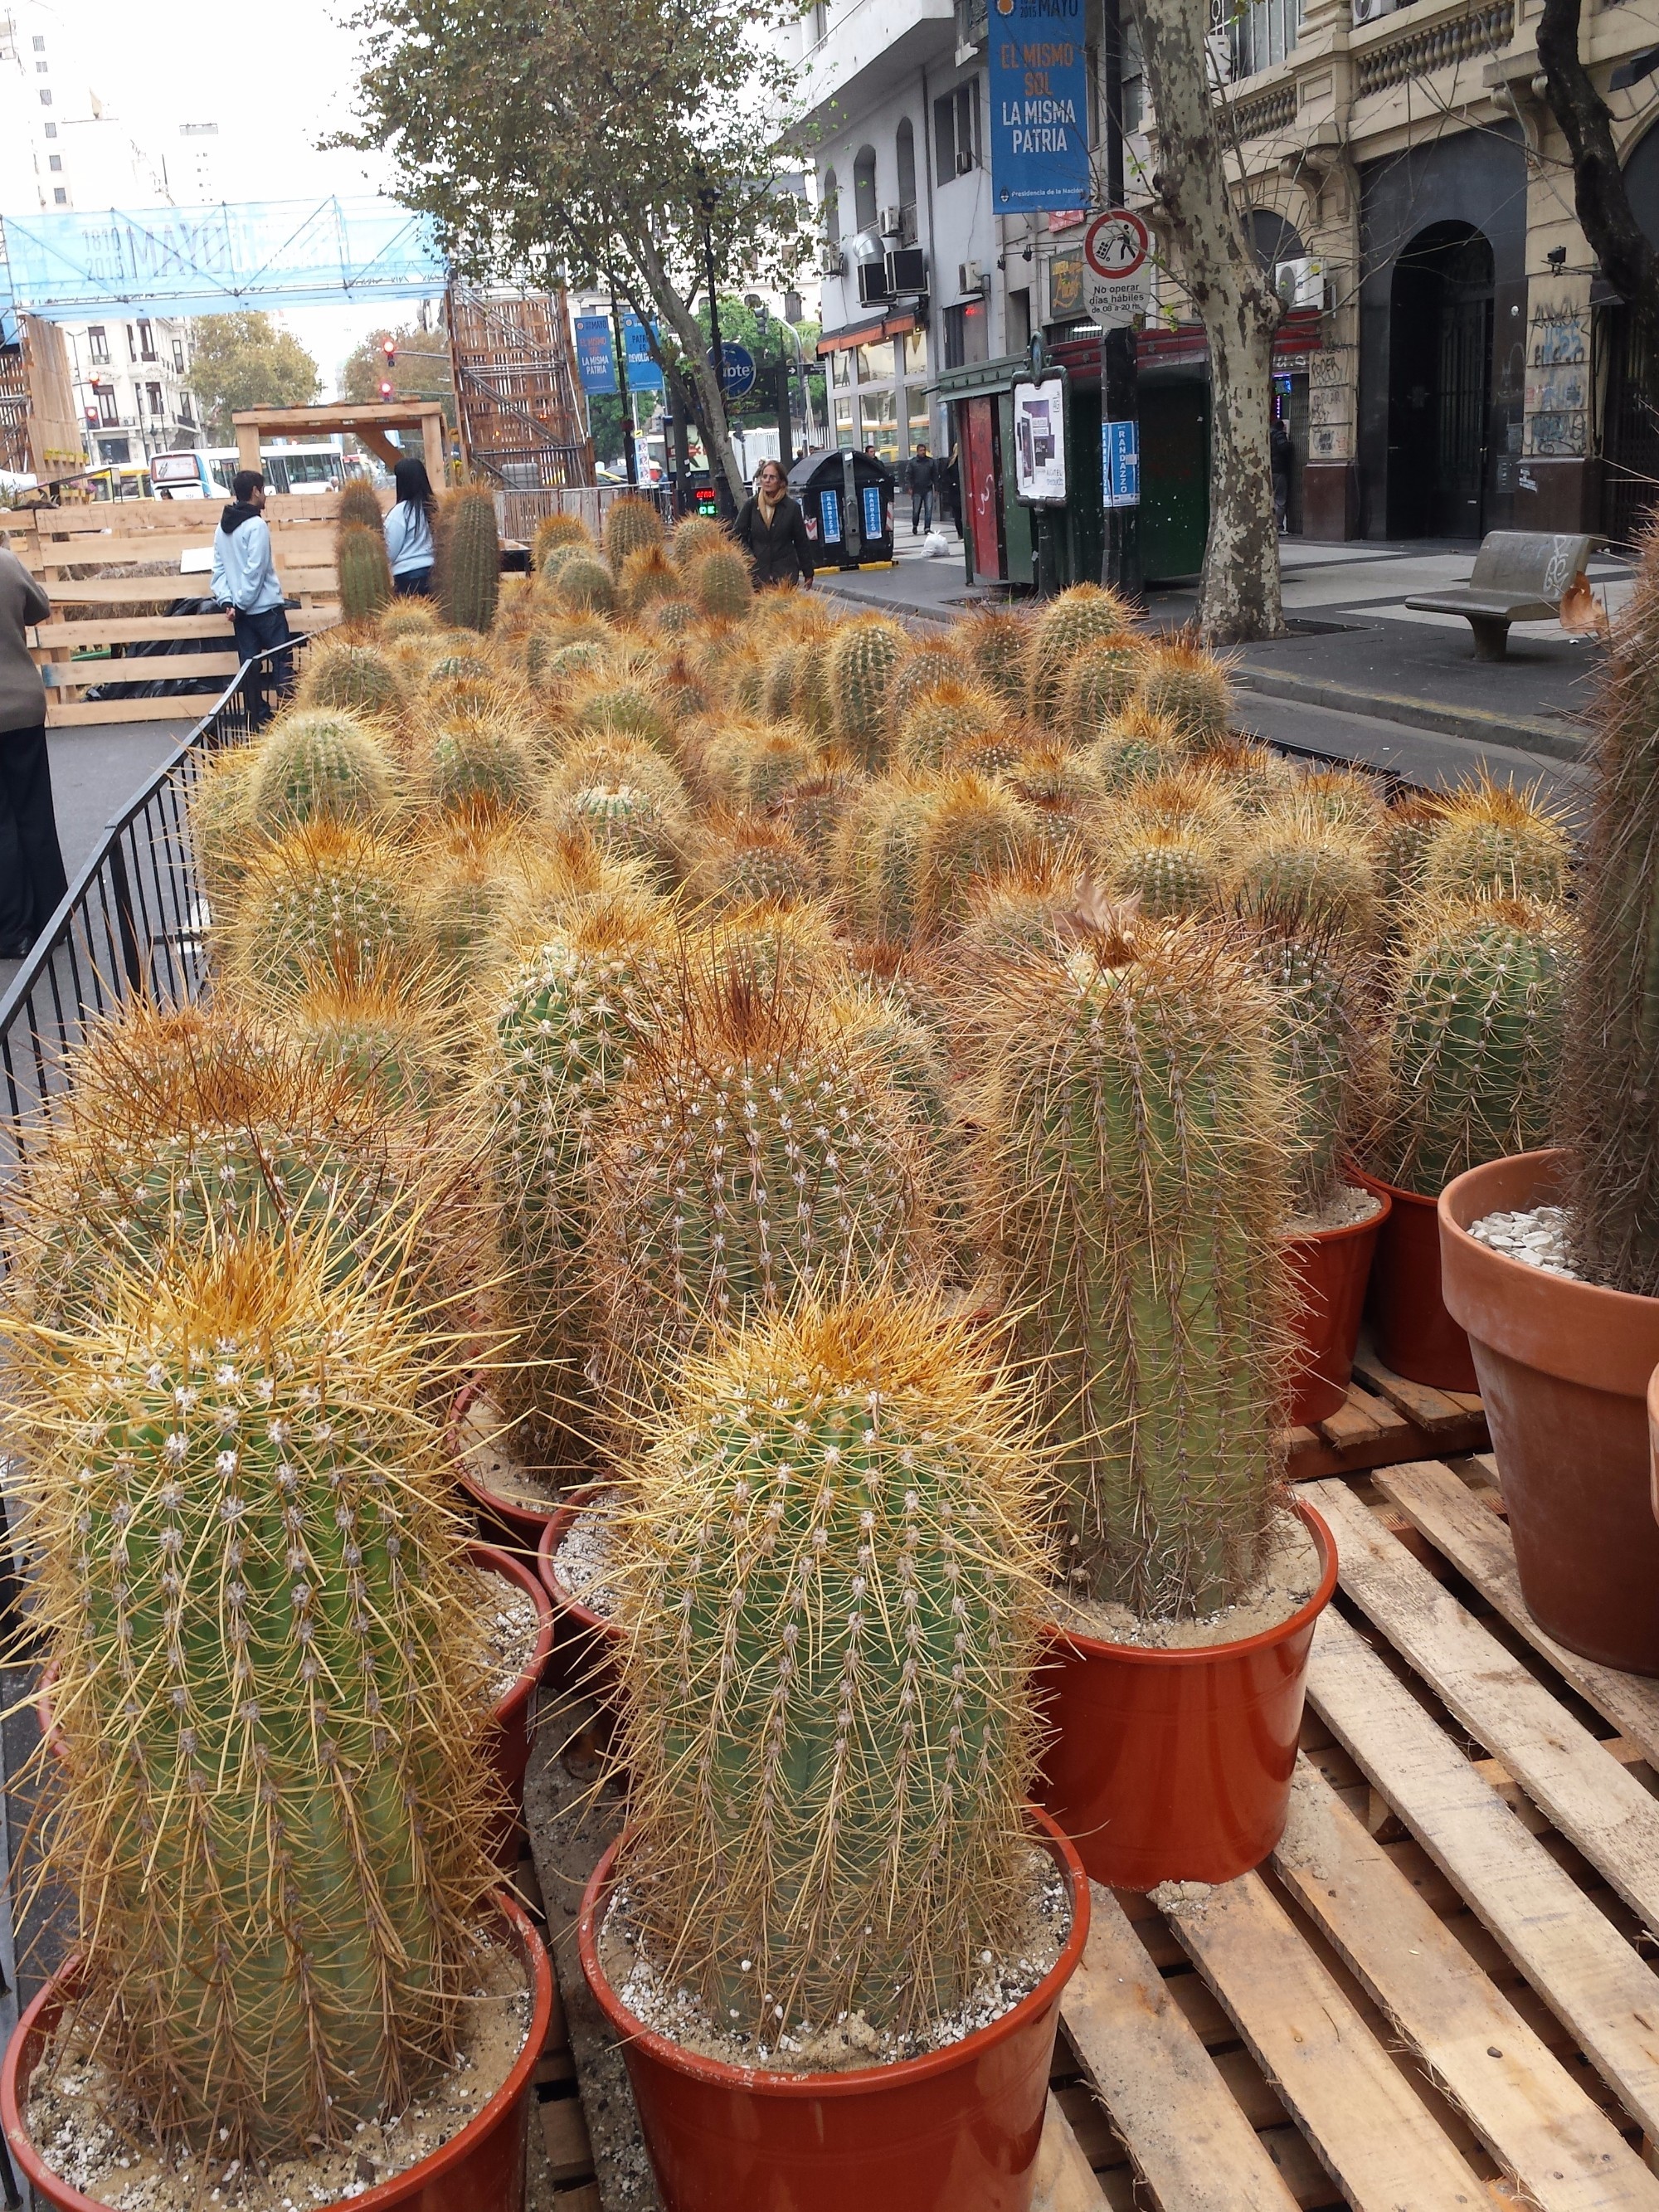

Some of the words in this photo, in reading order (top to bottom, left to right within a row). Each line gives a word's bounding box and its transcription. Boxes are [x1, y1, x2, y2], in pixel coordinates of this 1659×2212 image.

[1000, 43, 1019, 69] EL
[1023, 42, 1073, 67] MISMO
[1024, 71, 1053, 96] SOL
[1002, 101, 1022, 125] LA
[1024, 100, 1076, 124] MISMA
[1013, 128, 1068, 153] PATRIA
[82, 227, 120, 251] 1810
[126, 222, 226, 276] MAYO
[85, 256, 124, 279] 2015
[1110, 285, 1140, 295] operar
[591, 321, 607, 329] MAYO
[631, 334, 647, 343] PATR
[581, 357, 590, 366] LA
[590, 355, 609, 365] MISMA
[586, 365, 607, 375] PATRIA
[1118, 431, 1127, 493] RANDAZZO
[826, 496, 834, 534] RANDAZZO
